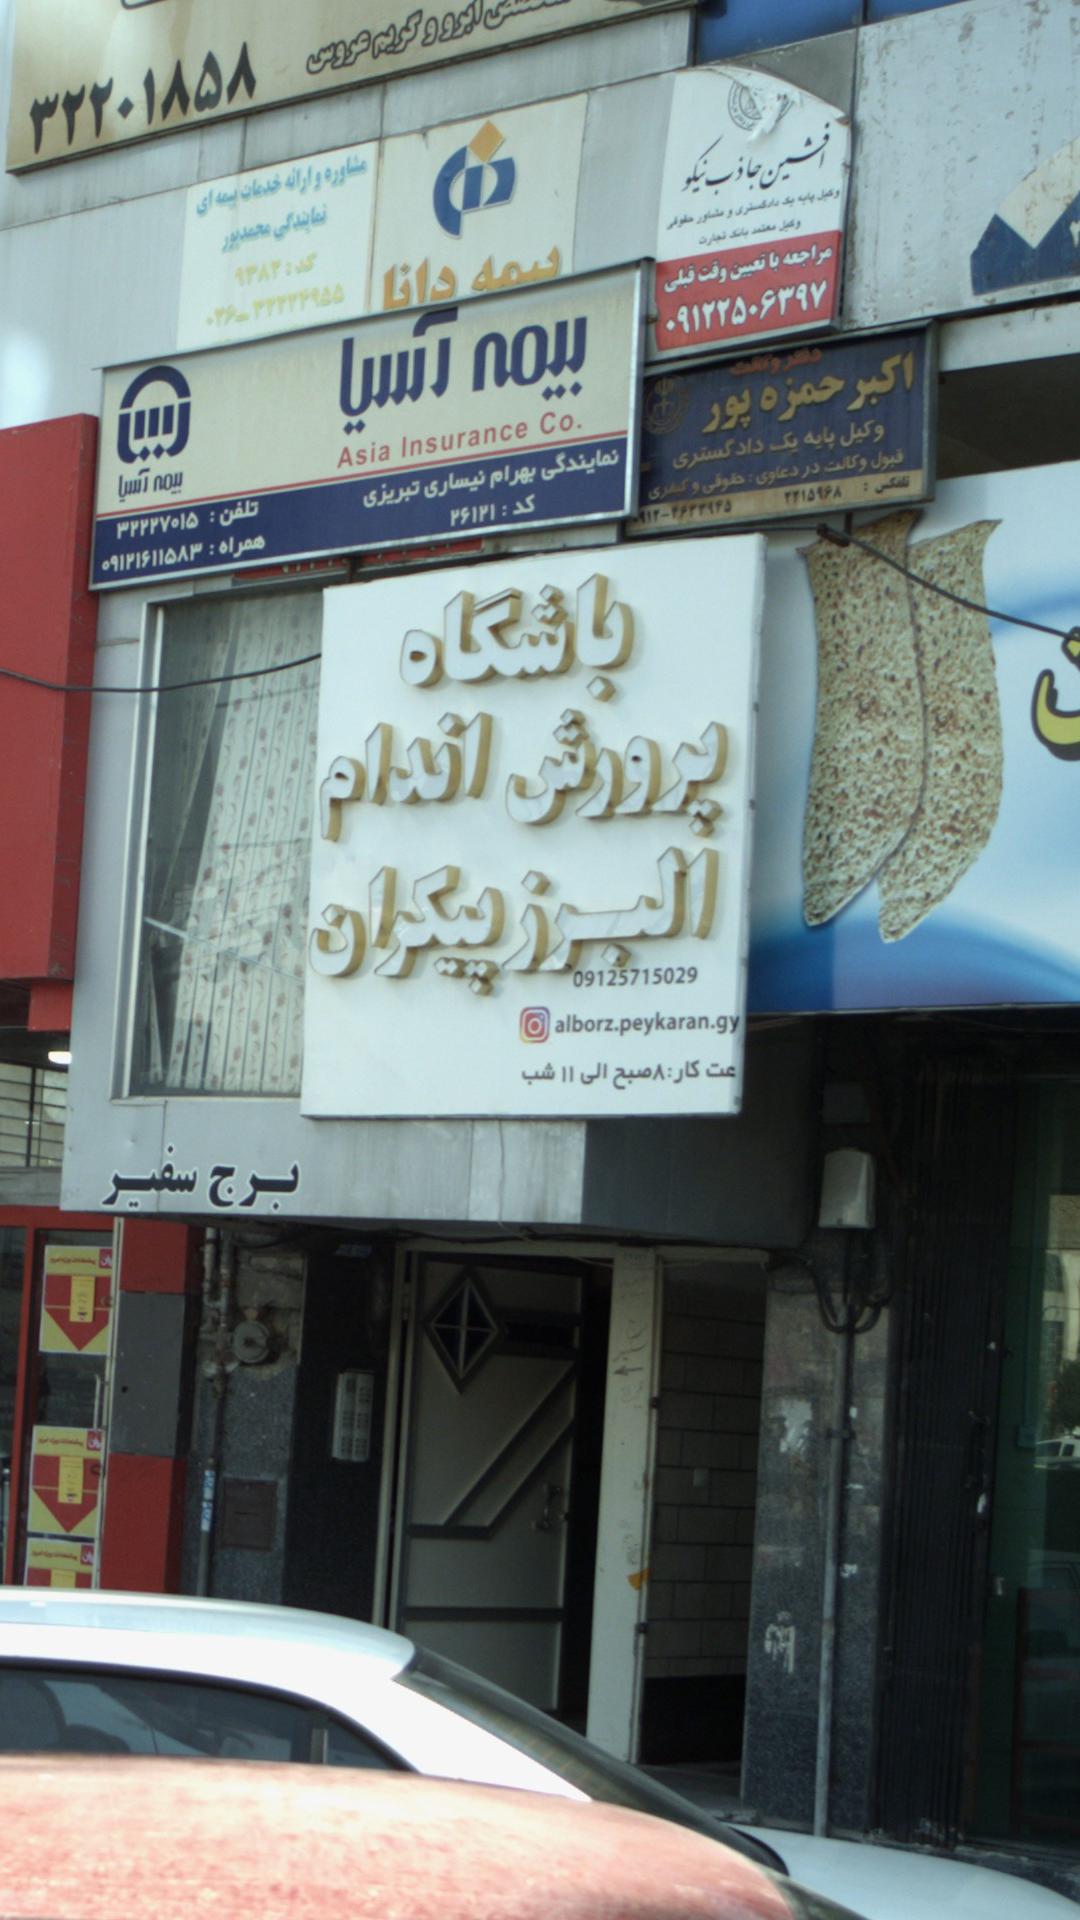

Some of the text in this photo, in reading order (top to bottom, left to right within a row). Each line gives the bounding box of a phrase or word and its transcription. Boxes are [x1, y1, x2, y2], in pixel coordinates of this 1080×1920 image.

[306, 30, 371, 74] عروس
[28, 41, 257, 154] ۳۲۲۰۱۸۵۸
[240, 173, 282, 199] خدمات
[324, 155, 368, 186] مشاوره
[816, 188, 841, 202] وکیل
[272, 203, 329, 240] نمایندگی
[778, 218, 802, 233] وکیل
[383, 256, 457, 311] دانا
[663, 244, 833, 294] مراجعه با تعیین وقت قبلی
[665, 280, 828, 335] ۰۹۱۲۲۵۰۶۳۹۷
[337, 307, 588, 435] بیمه آسیا
[846, 352, 915, 411] اکبر
[702, 386, 753, 433] پور
[759, 372, 846, 422] حمزه
[336, 407, 584, 470] Asia Insurance Co.
[672, 419, 886, 470] وکیل پایه یک دادگستری
[801, 460, 821, 479] در
[824, 452, 867, 473] وکالت
[869, 447, 905, 469] قبول
[117, 467, 184, 503] بیمه آسیا
[362, 449, 620, 511] نمایندگی بهرام نیساری تبریزی
[116, 510, 199, 541] ۳۲۲۲۷۰۱۵
[449, 503, 497, 527] ۲۶۱۲۱
[101, 541, 204, 573] ۰۹۱۲۱۶۱۱۵۸۳
[400, 573, 634, 700] باشگاه
[319, 708, 728, 842] پرورش اندام
[572, 965, 698, 988] 09125715029
[554, 1012, 740, 1038] alborz.peykaran.gy
[520, 1061, 556, 1084] شب
[580, 1062, 608, 1085] الی
[102, 1143, 299, 1209] برج سفیر
